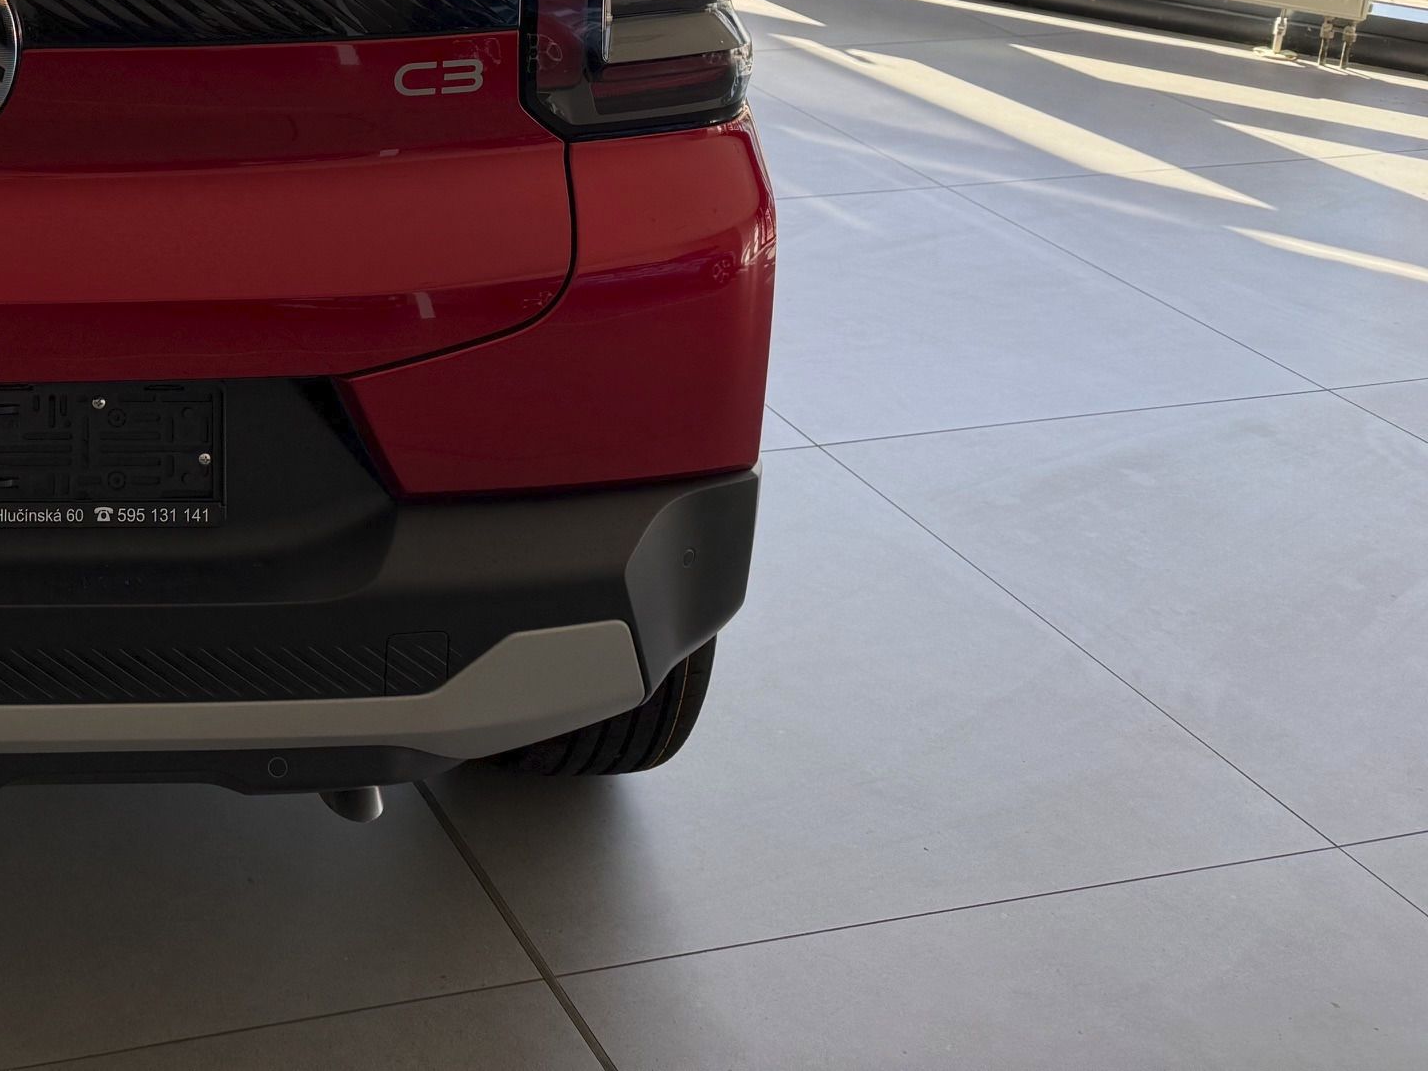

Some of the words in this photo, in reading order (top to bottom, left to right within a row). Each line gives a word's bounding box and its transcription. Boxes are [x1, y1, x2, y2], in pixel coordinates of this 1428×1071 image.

[393, 58, 484, 97] C3
[66, 508, 84, 522] 60
[117, 507, 146, 523] 595
[151, 507, 176, 523] 131
[183, 507, 209, 523] 141
